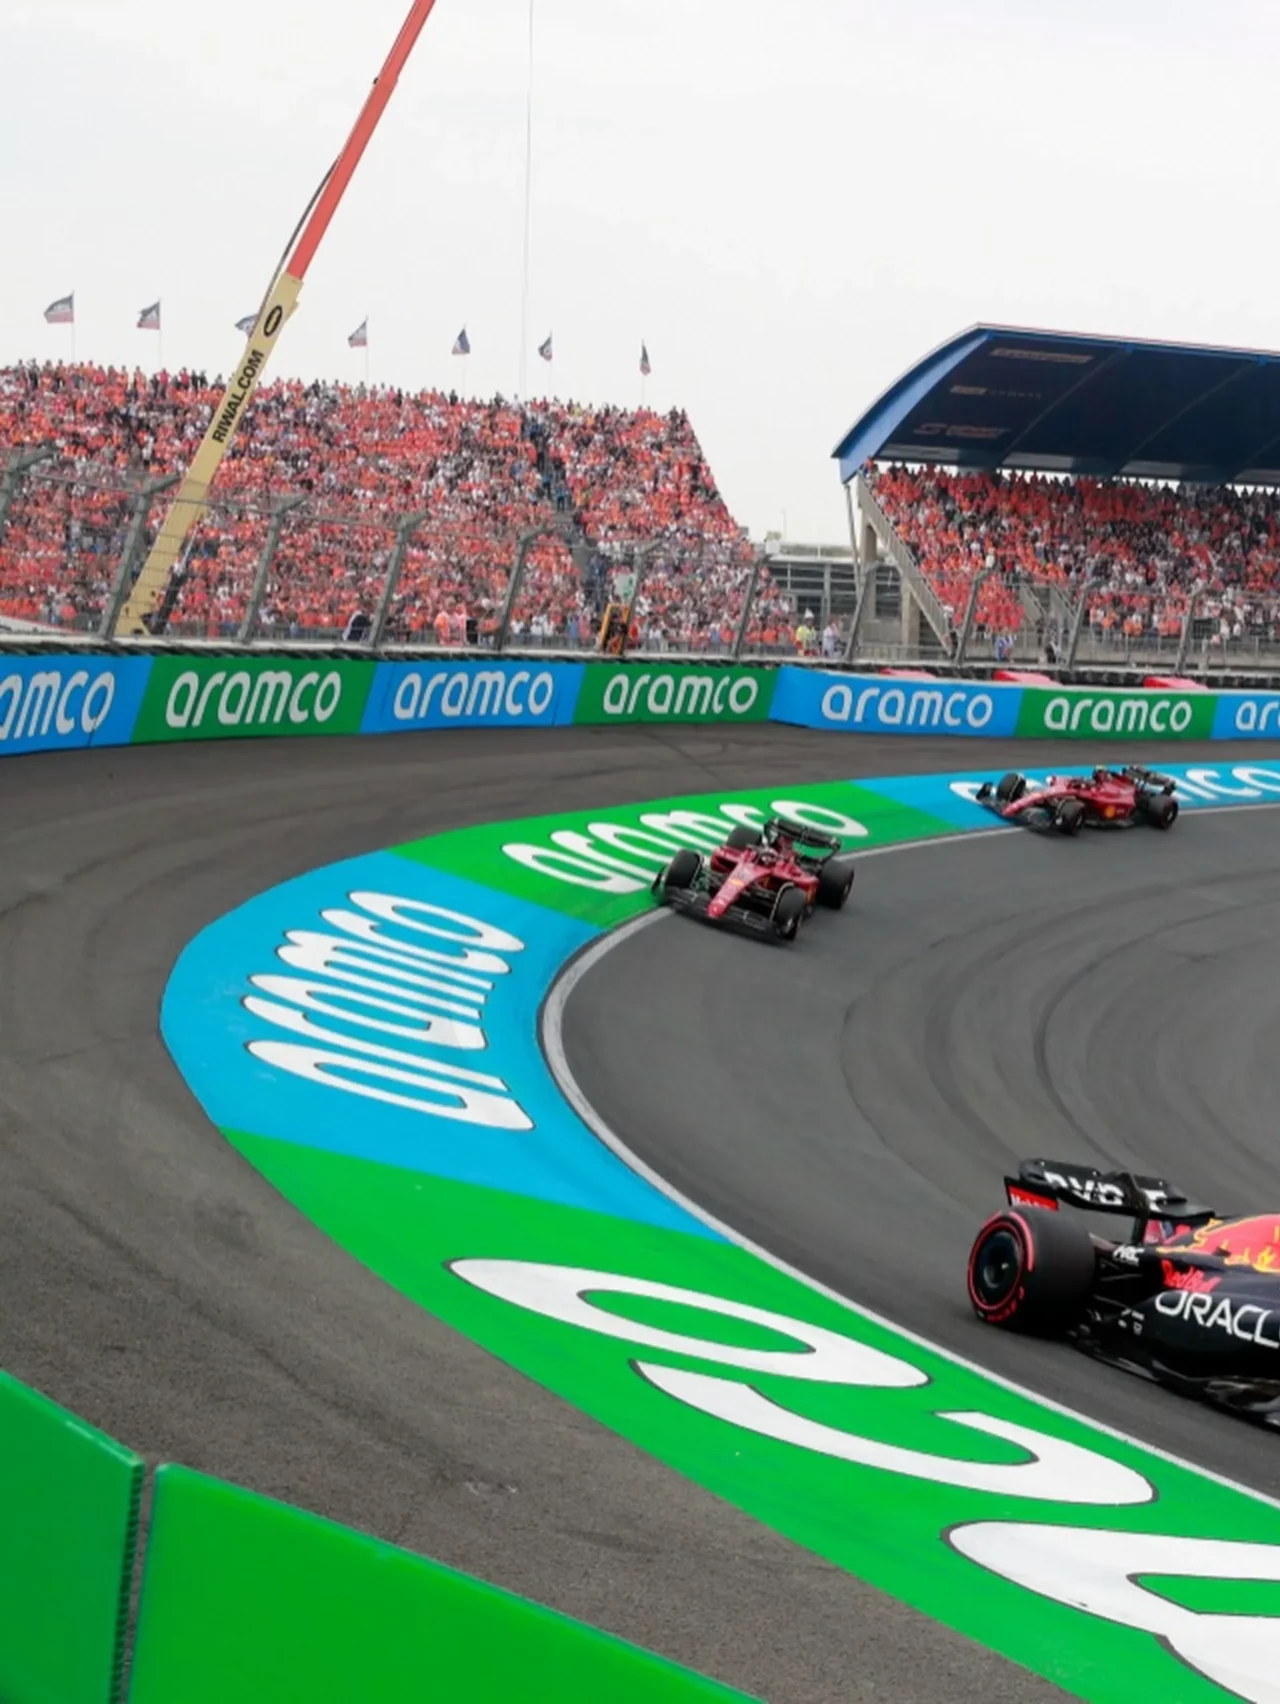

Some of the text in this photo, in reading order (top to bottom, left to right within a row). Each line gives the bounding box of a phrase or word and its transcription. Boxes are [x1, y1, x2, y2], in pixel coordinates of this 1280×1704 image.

[211, 349, 264, 444] RIWAL.COM
[165, 671, 342, 728] aramco
[393, 671, 554, 720] aramco
[602, 675, 758, 714] aramco
[821, 684, 993, 728] aramco
[1044, 698, 1193, 732] aramco
[241, 889, 536, 1131] aramco
